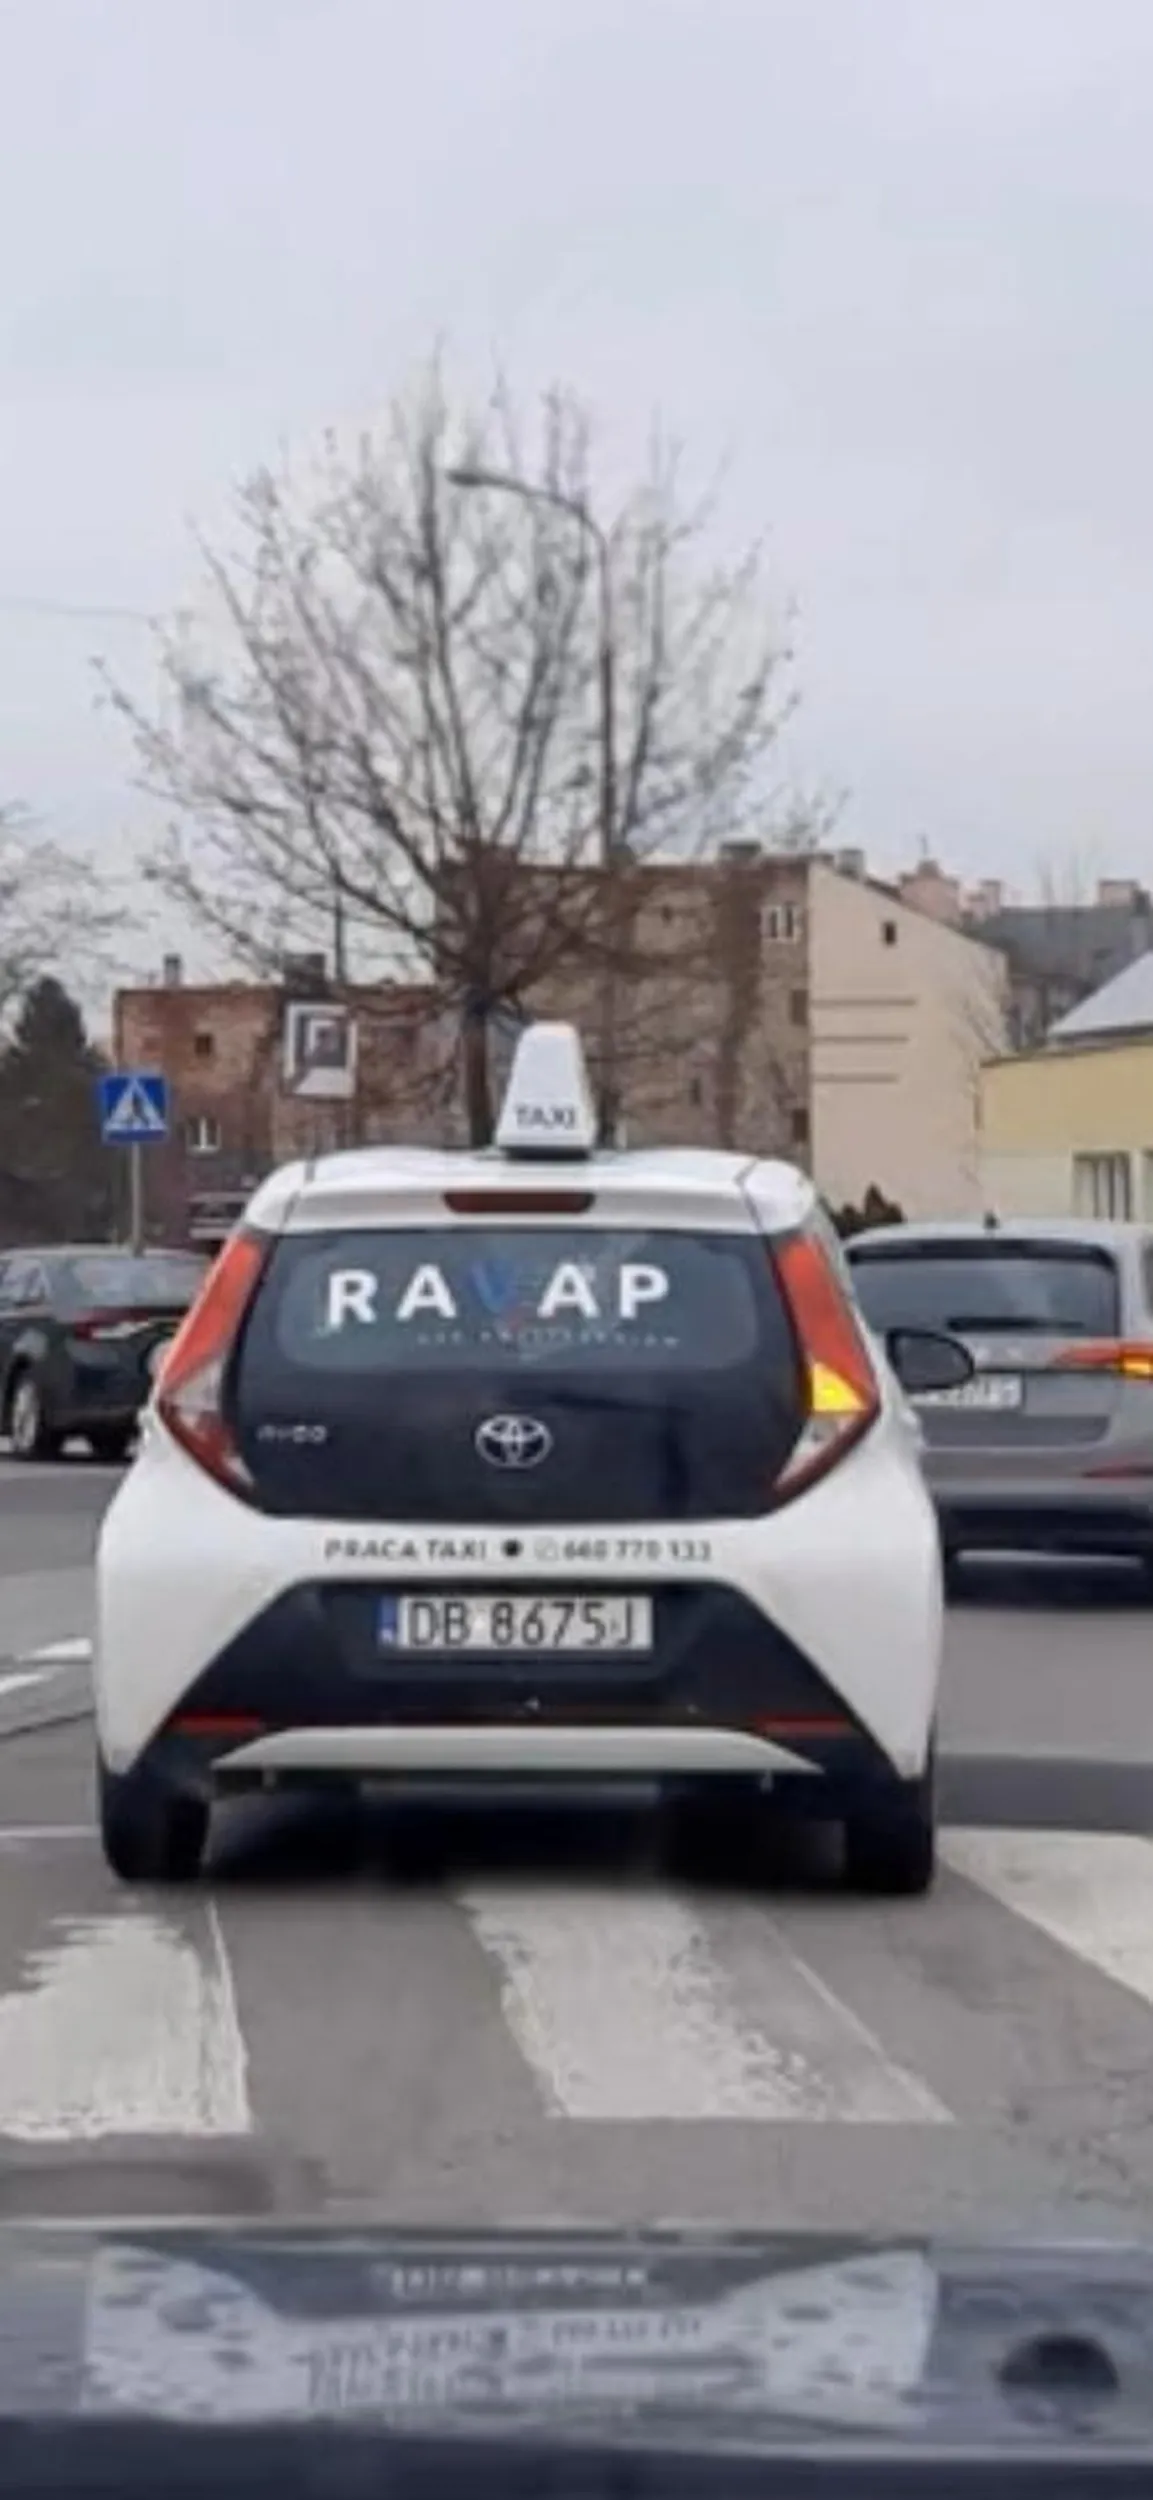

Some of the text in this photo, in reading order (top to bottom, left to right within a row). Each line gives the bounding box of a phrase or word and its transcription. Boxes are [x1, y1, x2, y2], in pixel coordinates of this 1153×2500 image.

[516, 1105, 575, 1130] TAXI
[324, 1537, 419, 1562] PRACA
[427, 1537, 487, 1562] TAXI
[409, 1600, 634, 1646] DB 8675J
